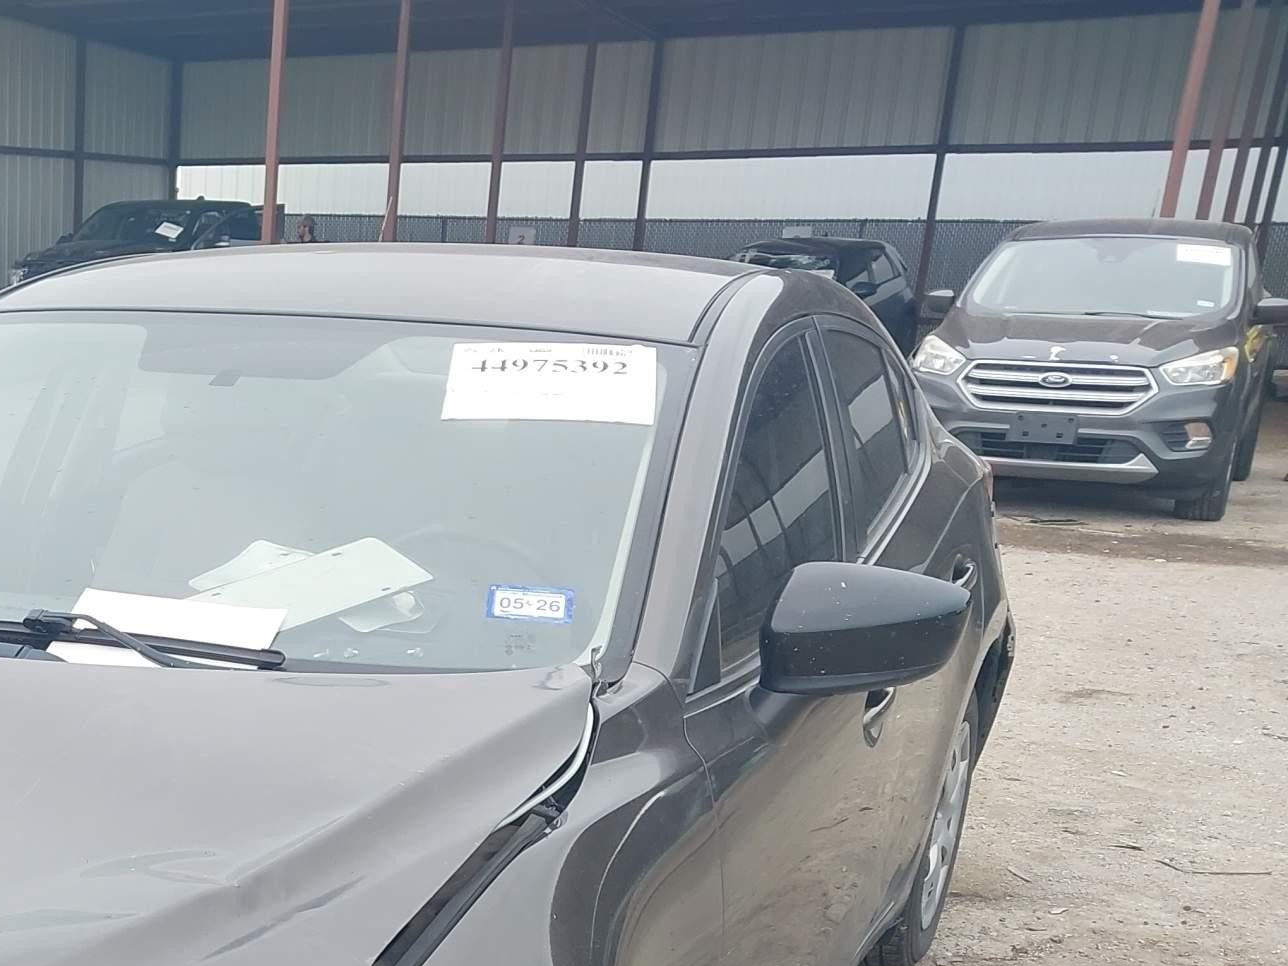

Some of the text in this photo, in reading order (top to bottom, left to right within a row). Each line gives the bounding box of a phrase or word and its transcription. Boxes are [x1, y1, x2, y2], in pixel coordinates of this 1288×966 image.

[471, 358, 629, 375] 44975392
[499, 597, 561, 612] 05 26
